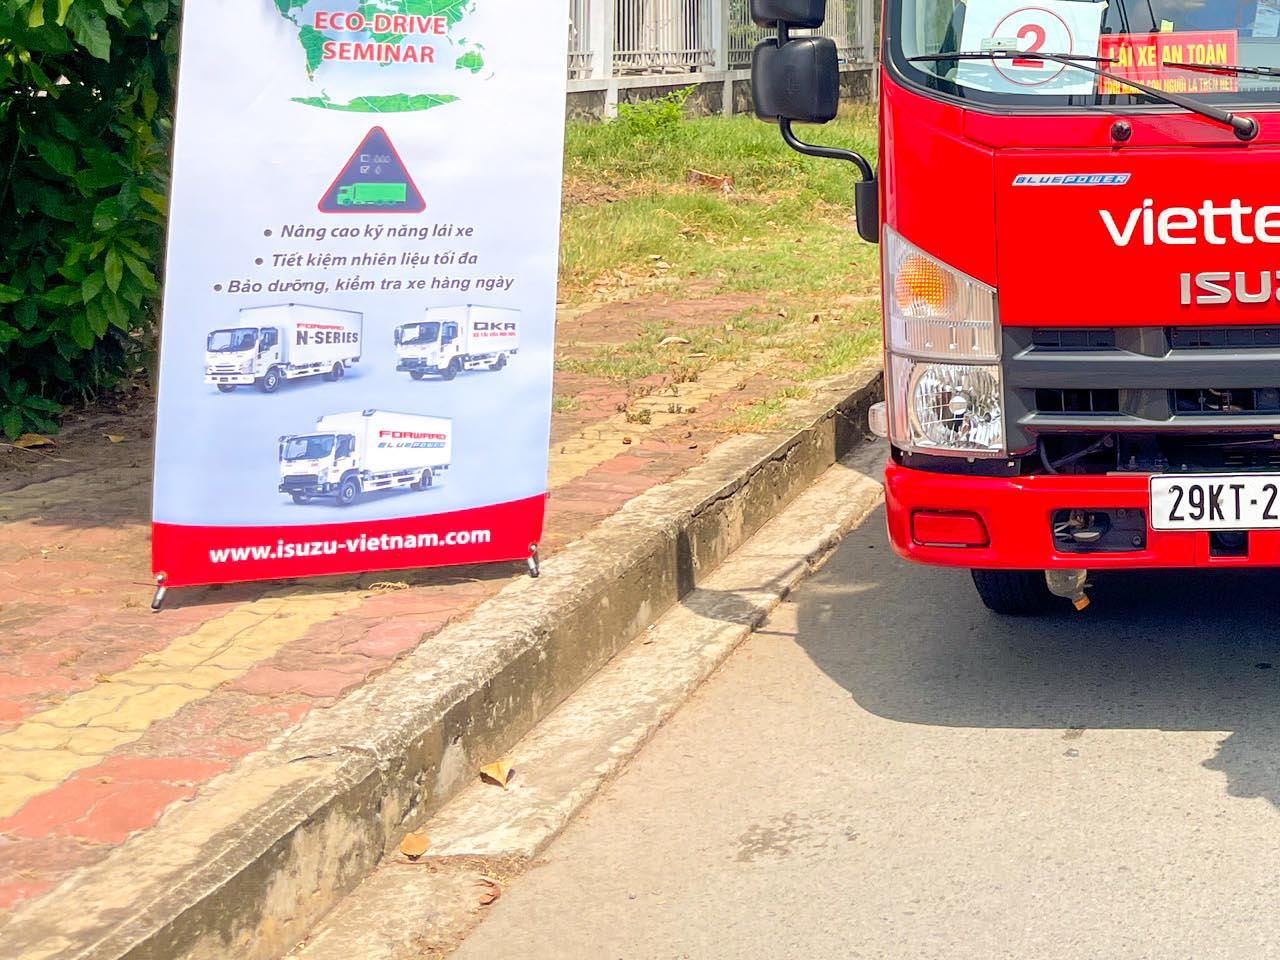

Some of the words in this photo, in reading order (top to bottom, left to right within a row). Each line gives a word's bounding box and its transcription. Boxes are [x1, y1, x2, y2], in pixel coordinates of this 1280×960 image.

[314, 12, 446, 35] ECO-DRIVE
[322, 42, 435, 64] SEMINAR
[1012, 24, 1046, 68] 2
[1109, 43, 1133, 67] LÁI
[1137, 46, 1156, 66] XE
[1162, 45, 1182, 63] AN
[1187, 40, 1227, 64] TOÀN
[1016, 175, 1128, 184] BLUEPOWER
[281, 224, 326, 240] Nâng
[331, 227, 360, 238] cao
[363, 224, 384, 240] kỹ
[387, 225, 428, 240] năng
[433, 224, 453, 237] lái
[456, 228, 473, 237] xe
[273, 252, 303, 267] Tiết
[307, 253, 347, 269] kiệm
[351, 253, 396, 266] nhiên
[400, 252, 429, 268] liệu
[433, 250, 454, 265] tối
[458, 252, 478, 265] đa
[228, 279, 262, 293] Bảo
[268, 279, 329, 295] dưỡng,
[335, 275, 375, 291] kiểm
[380, 279, 402, 290] tra
[408, 280, 426, 290] xe
[430, 277, 471, 291] hàng
[475, 277, 514, 291] ngày
[296, 331, 358, 345] N-SERIES
[379, 431, 446, 440] FORWARD
[209, 527, 490, 563] www.isuzu-vietnam.com
